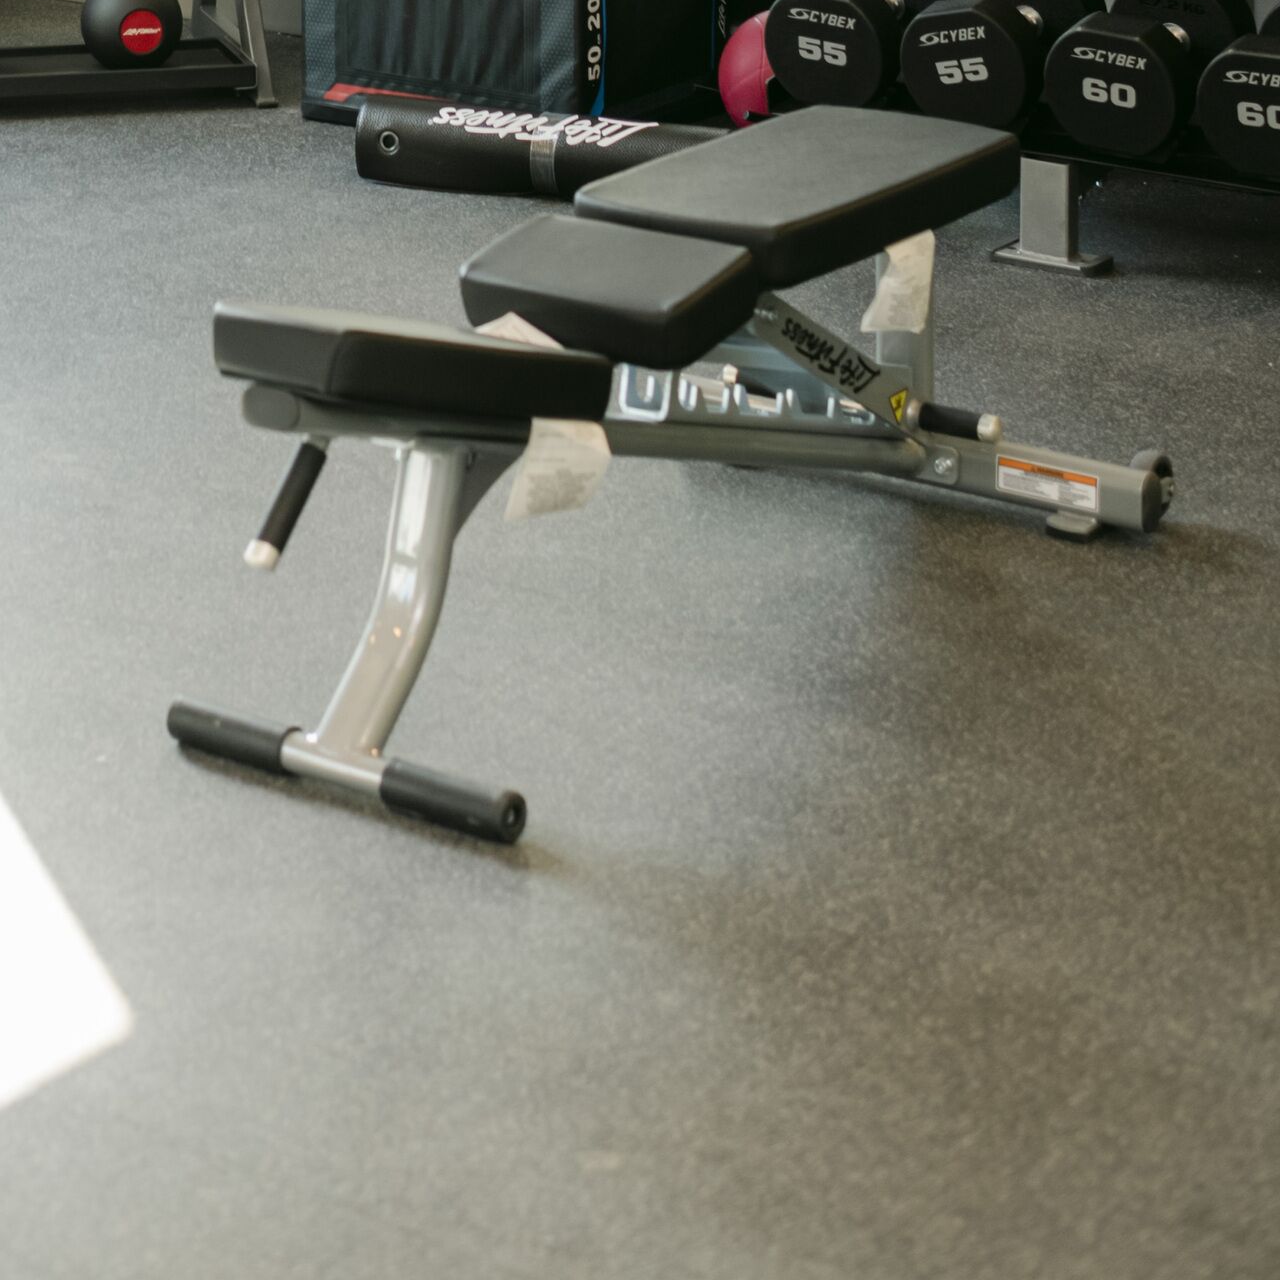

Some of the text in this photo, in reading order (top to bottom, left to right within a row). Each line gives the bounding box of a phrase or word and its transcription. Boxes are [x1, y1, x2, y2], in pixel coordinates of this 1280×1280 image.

[1181, 1, 1207, 17] KG
[808, 11, 857, 30] CYBEX
[939, 26, 986, 44] CYBEX
[798, 35, 848, 67] 55
[1094, 49, 1148, 71] CYBEX
[934, 56, 990, 85] 55
[1248, 71, 1280, 89] CYB
[1081, 76, 1137, 109] 60
